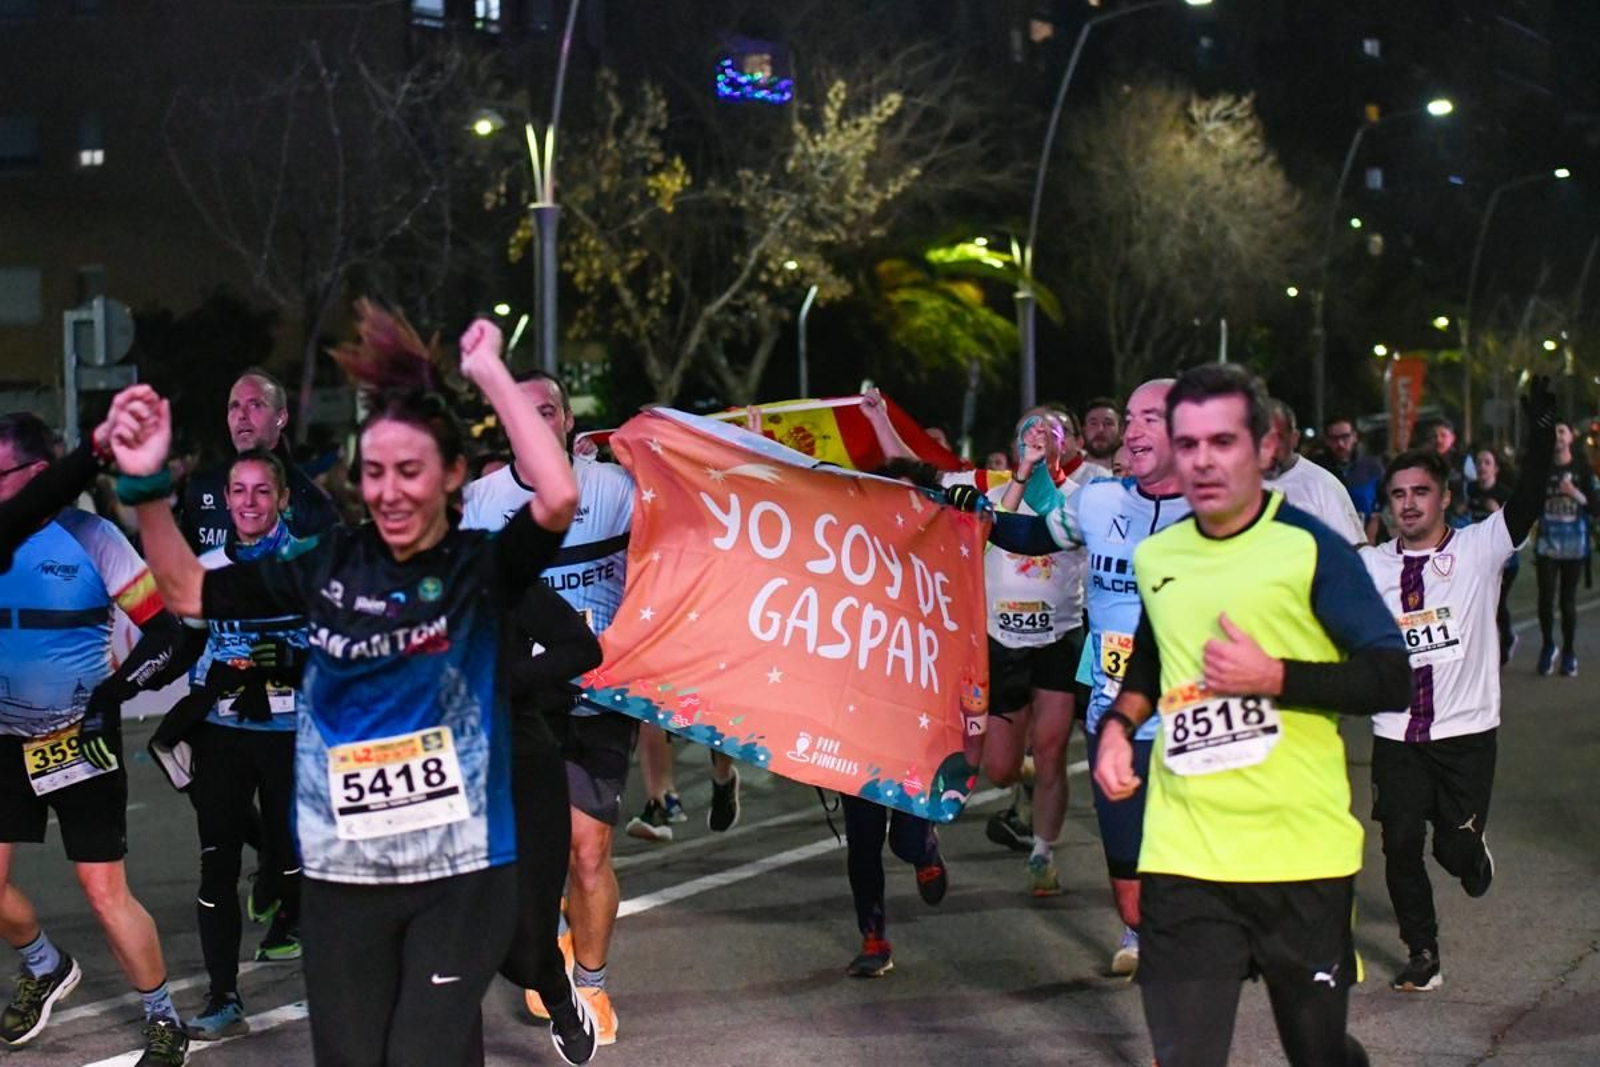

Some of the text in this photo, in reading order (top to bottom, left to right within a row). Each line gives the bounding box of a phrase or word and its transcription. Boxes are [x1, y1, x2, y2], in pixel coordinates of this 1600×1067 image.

[198, 526, 228, 546] SAN
[699, 491, 959, 631] YO SOY DE
[748, 577, 940, 694] GASPAR
[1107, 650, 1130, 673] 3
[1172, 694, 1265, 744] 8518
[343, 757, 447, 803] 5418
